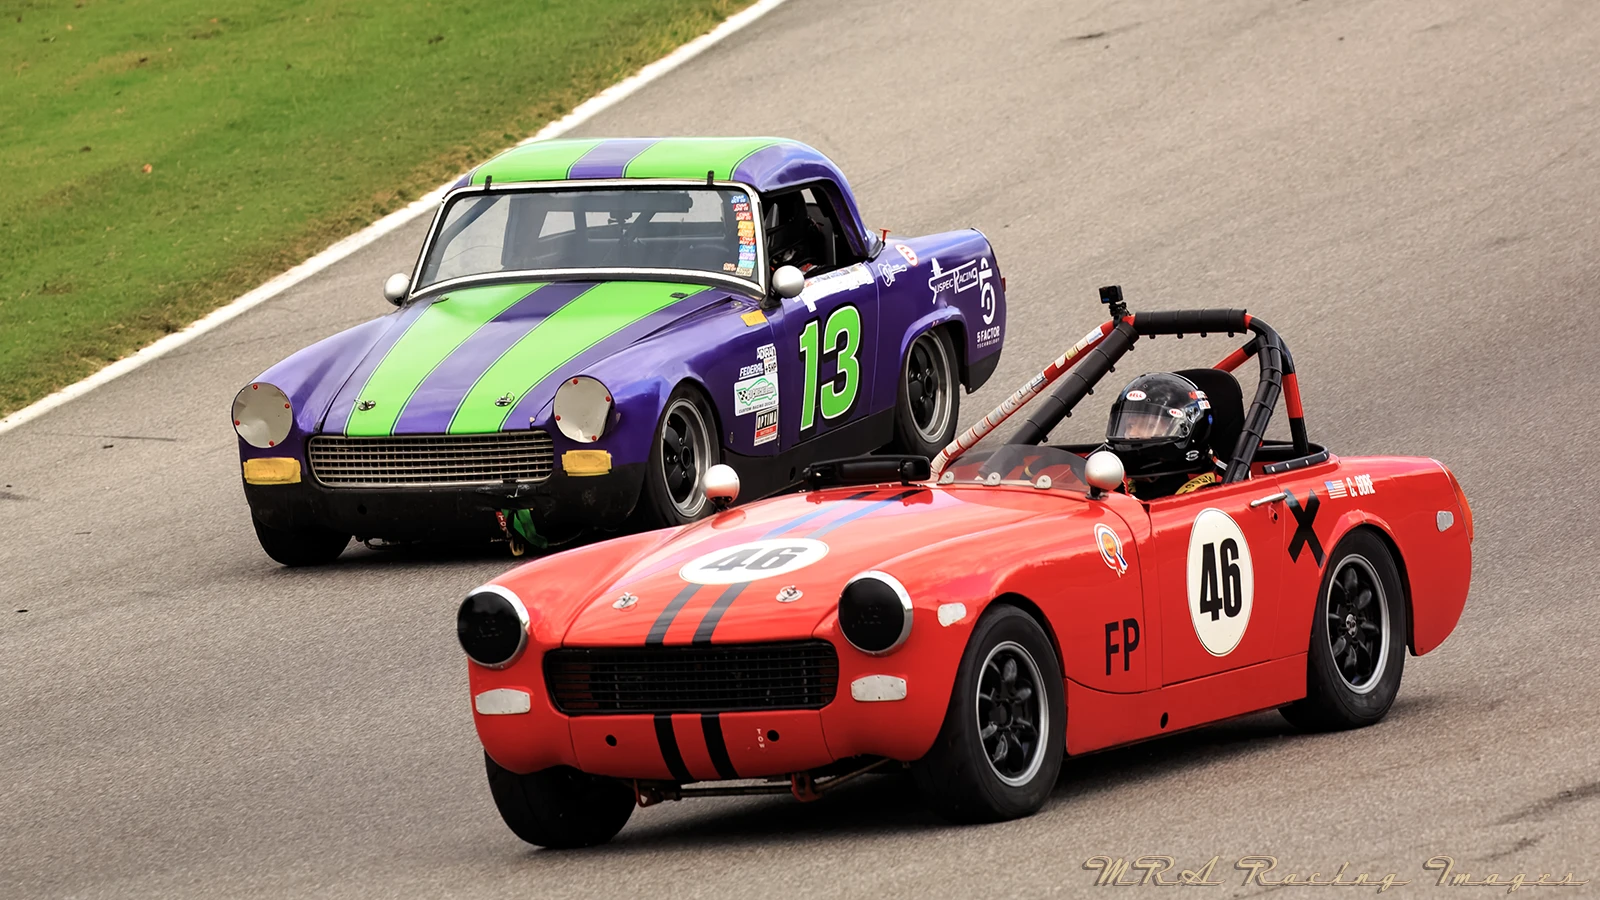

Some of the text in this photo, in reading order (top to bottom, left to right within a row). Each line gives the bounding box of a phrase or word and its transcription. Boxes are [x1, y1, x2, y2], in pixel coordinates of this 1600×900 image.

[976, 325, 1001, 343] 5 FACTOR
[976, 338, 1000, 349] TECHNOLOGY
[739, 362, 764, 378] FEDERAL
[799, 304, 862, 432] 13
[757, 411, 777, 430] OPTIMA
[700, 546, 808, 572] 46
[1199, 537, 1243, 622] 46
[1104, 617, 1141, 676] FP
